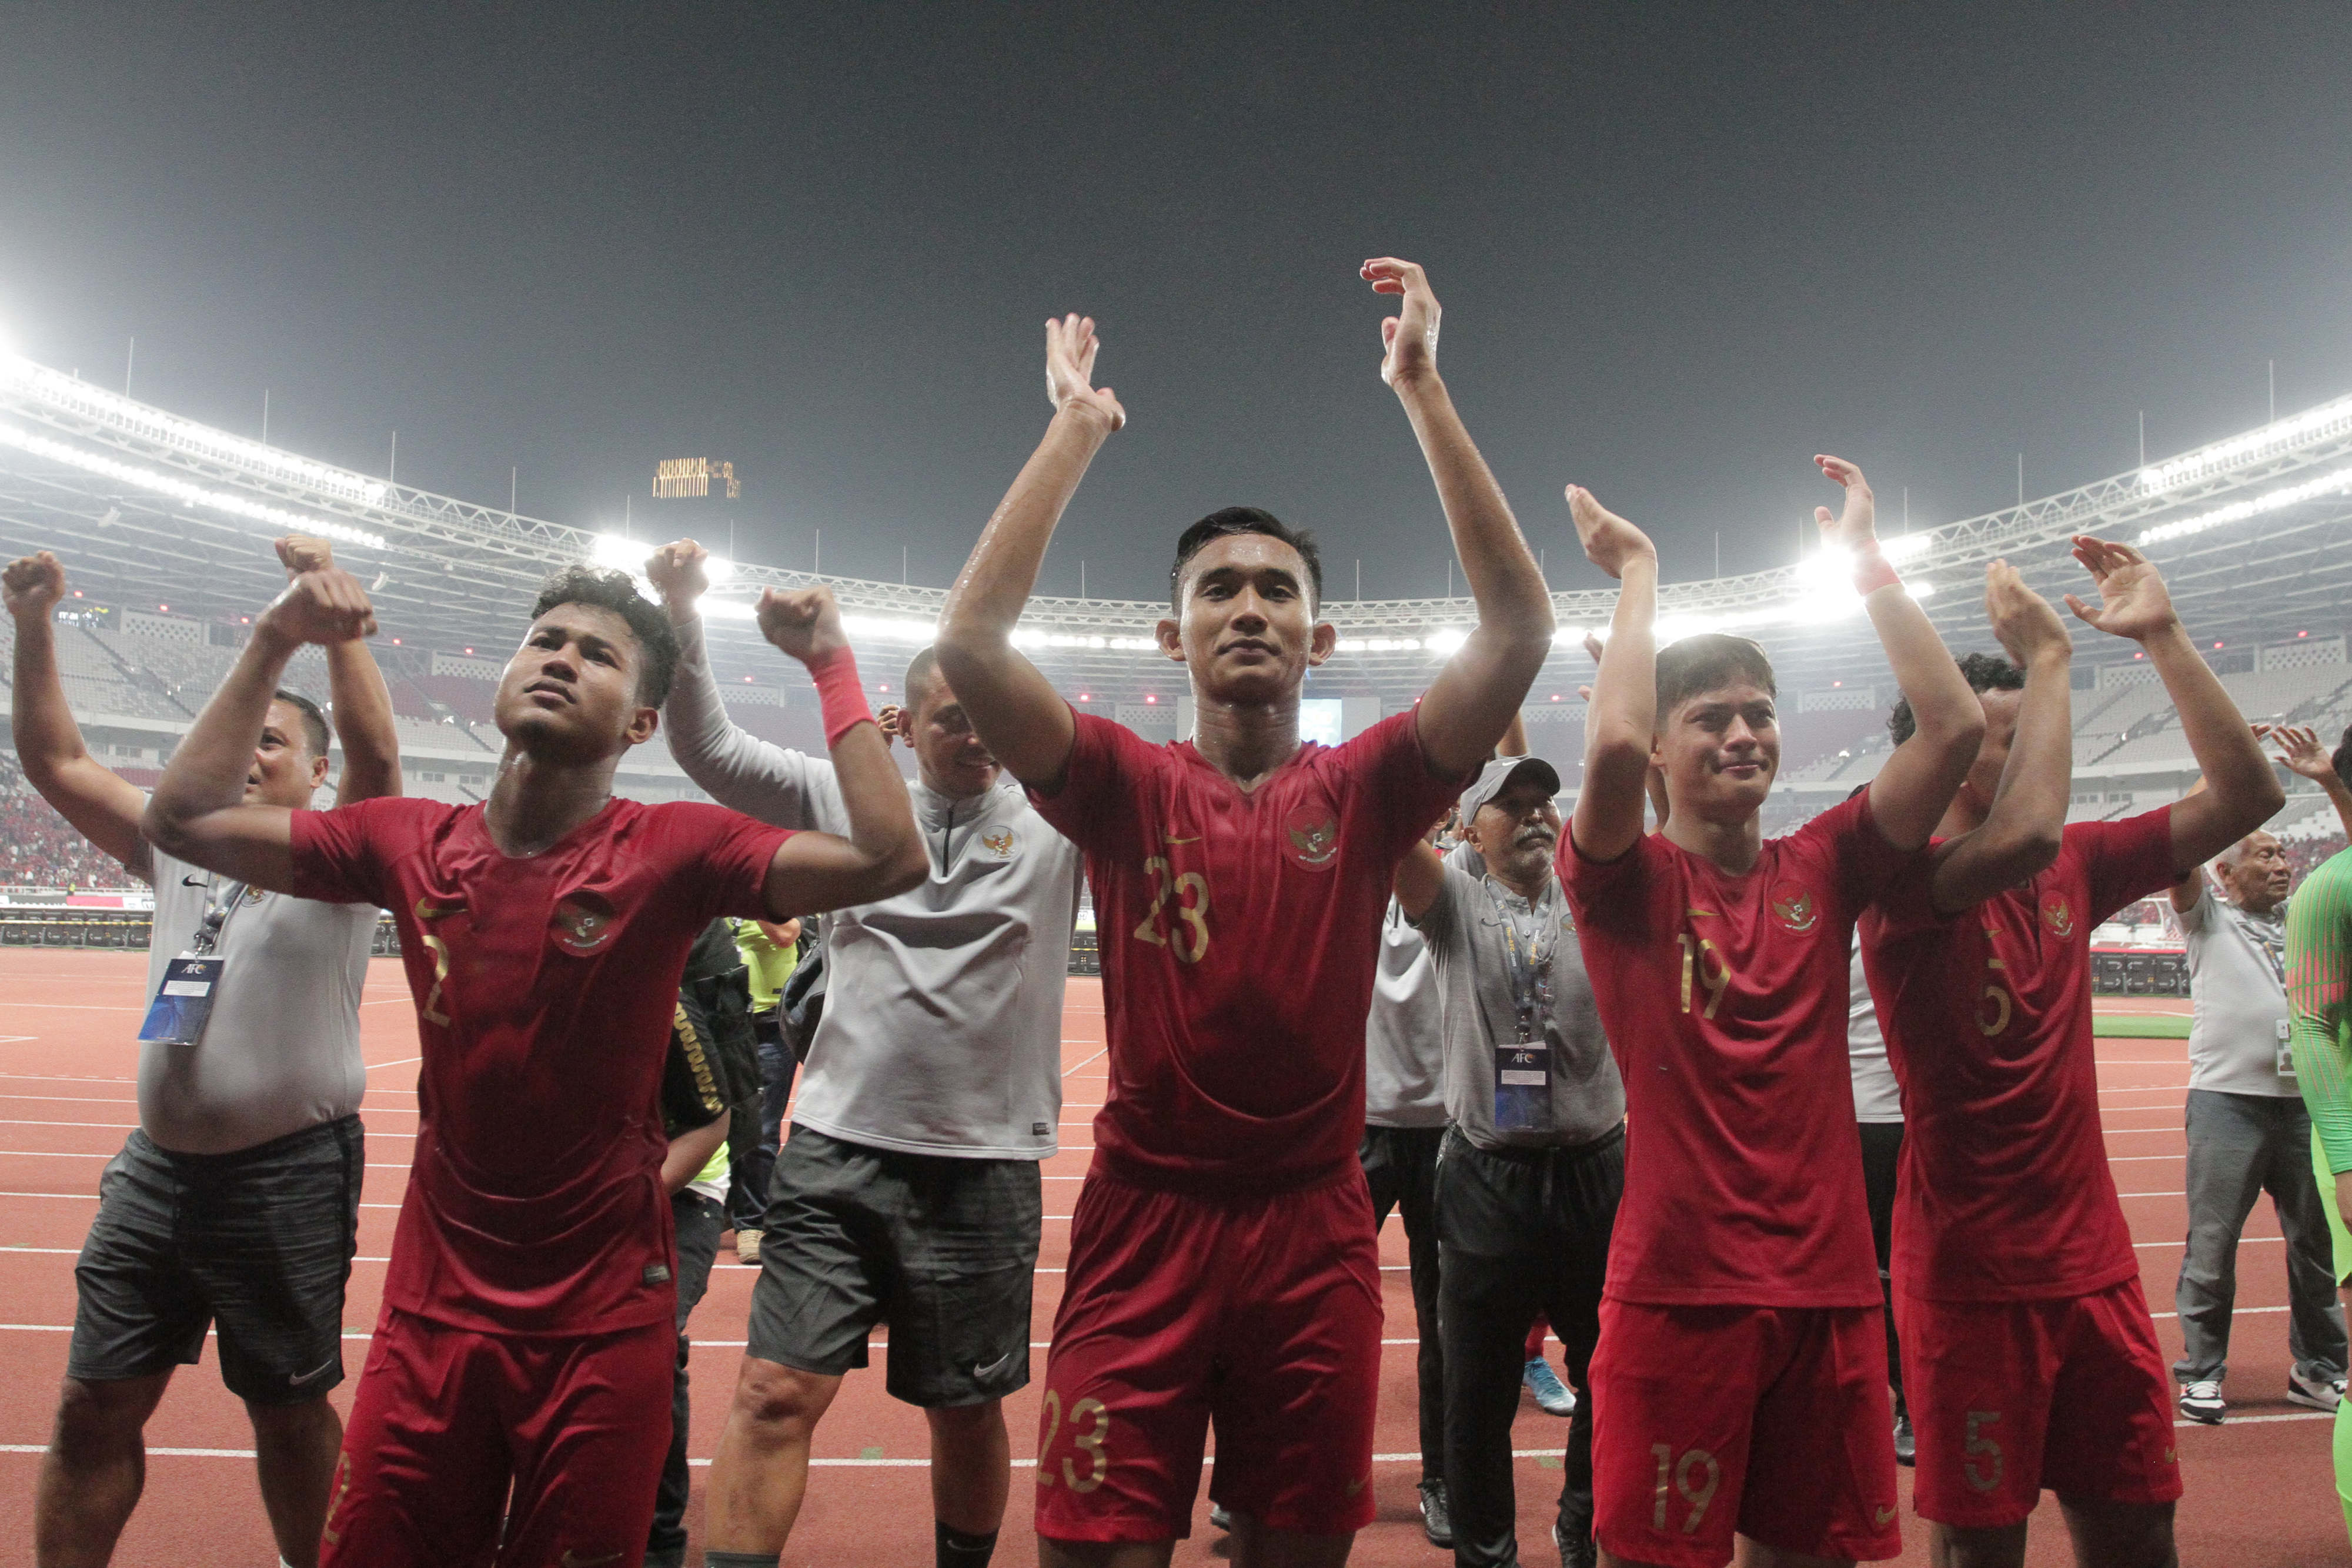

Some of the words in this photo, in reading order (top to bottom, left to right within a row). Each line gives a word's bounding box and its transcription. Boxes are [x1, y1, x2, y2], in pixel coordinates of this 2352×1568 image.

[1133, 855, 1209, 964] 23
[181, 964, 207, 974] AFC
[422, 935, 452, 1027] 2
[1677, 933, 1732, 1019] 19
[1511, 1053, 1535, 1064] AFC
[1036, 1389, 1109, 1493] 23
[1966, 1411, 2003, 1491] 5
[1651, 1443, 1719, 1534] 19
